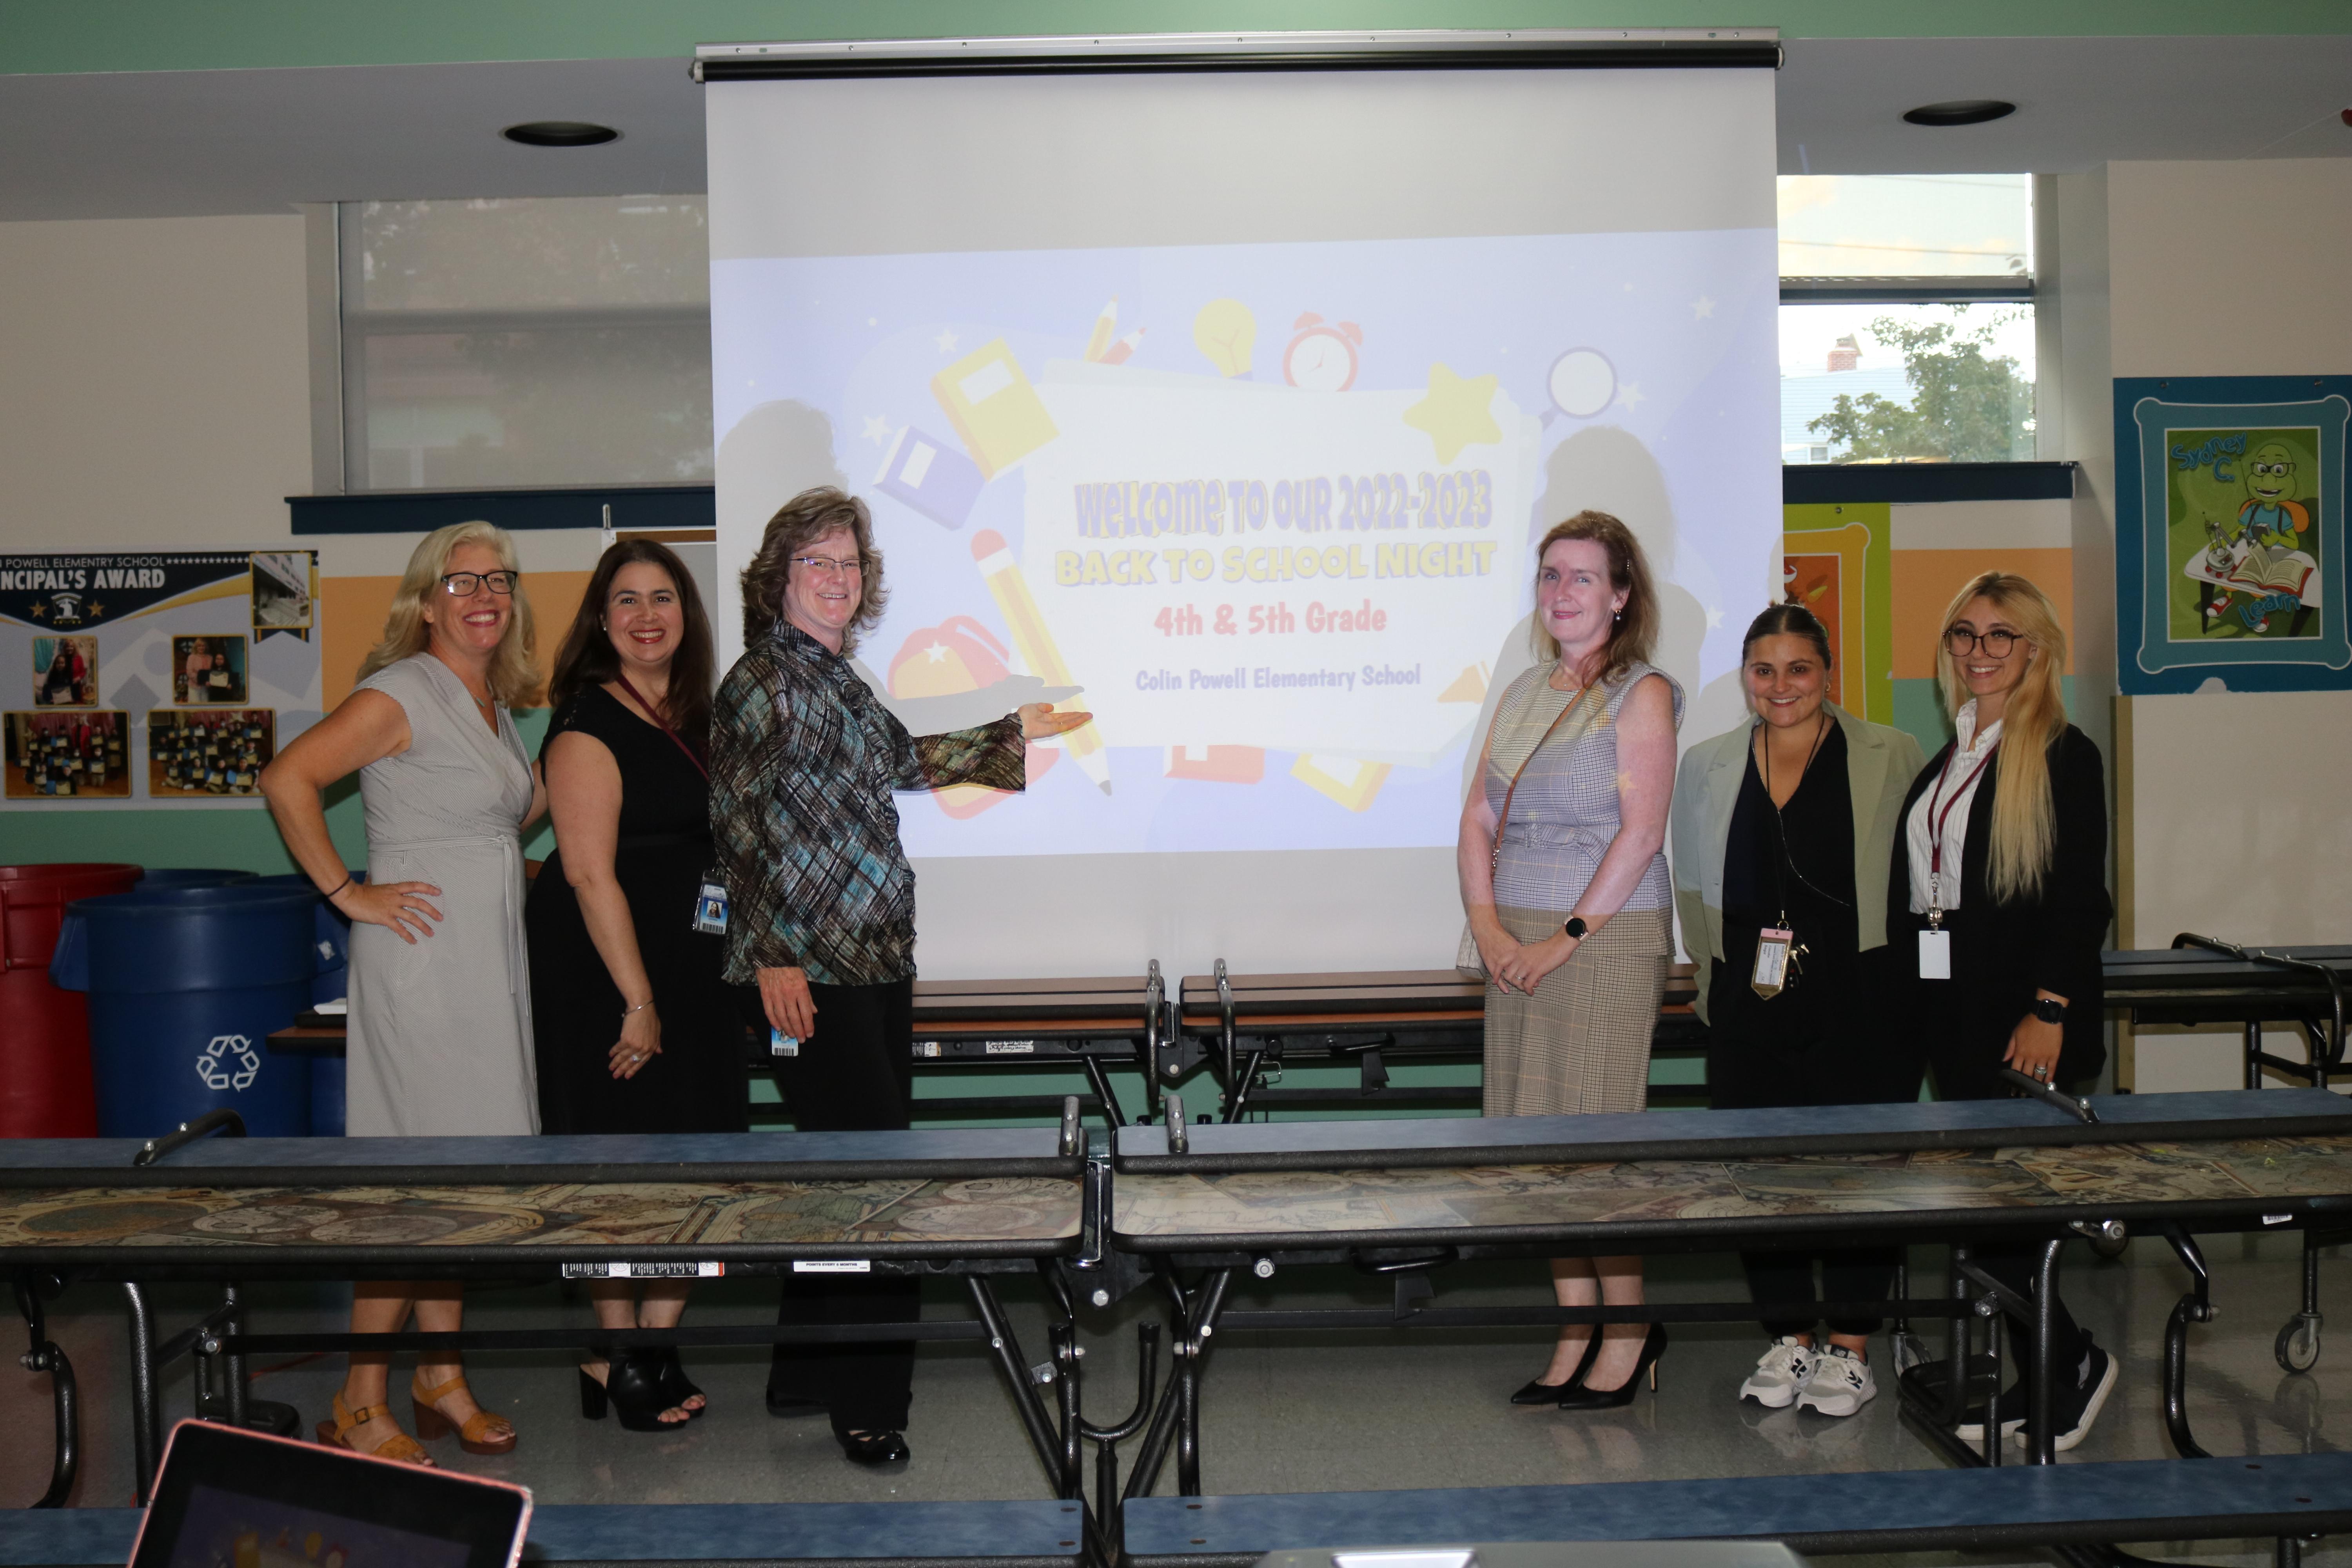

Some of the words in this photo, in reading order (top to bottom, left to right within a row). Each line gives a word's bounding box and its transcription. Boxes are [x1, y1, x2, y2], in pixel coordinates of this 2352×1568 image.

[2171, 432, 2247, 470] Sydney
[1228, 479, 1267, 533] TO
[1338, 469, 1492, 532] 2022-2023
[1, 569, 86, 590] NCIPAL'S
[93, 568, 165, 589] AWARD
[6, 558, 49, 568] POWELL
[53, 557, 113, 568] ELEMENTRY
[117, 557, 165, 567] SCHOOL
[1055, 550, 1158, 587] BACK
[1163, 548, 1214, 584] TO
[1222, 544, 1368, 583] SCHOOL
[1375, 541, 1497, 579] NIGHT
[1154, 604, 1203, 636] 4th
[1213, 604, 1238, 635] &
[1248, 602, 1294, 634] 5th
[1306, 599, 1387, 633] Grade
[2238, 593, 2301, 628] Learn
[1136, 669, 1182, 691] Colin
[1190, 667, 1246, 689] Powell
[1254, 666, 1356, 691] Elementary
[1362, 663, 1421, 686] School
